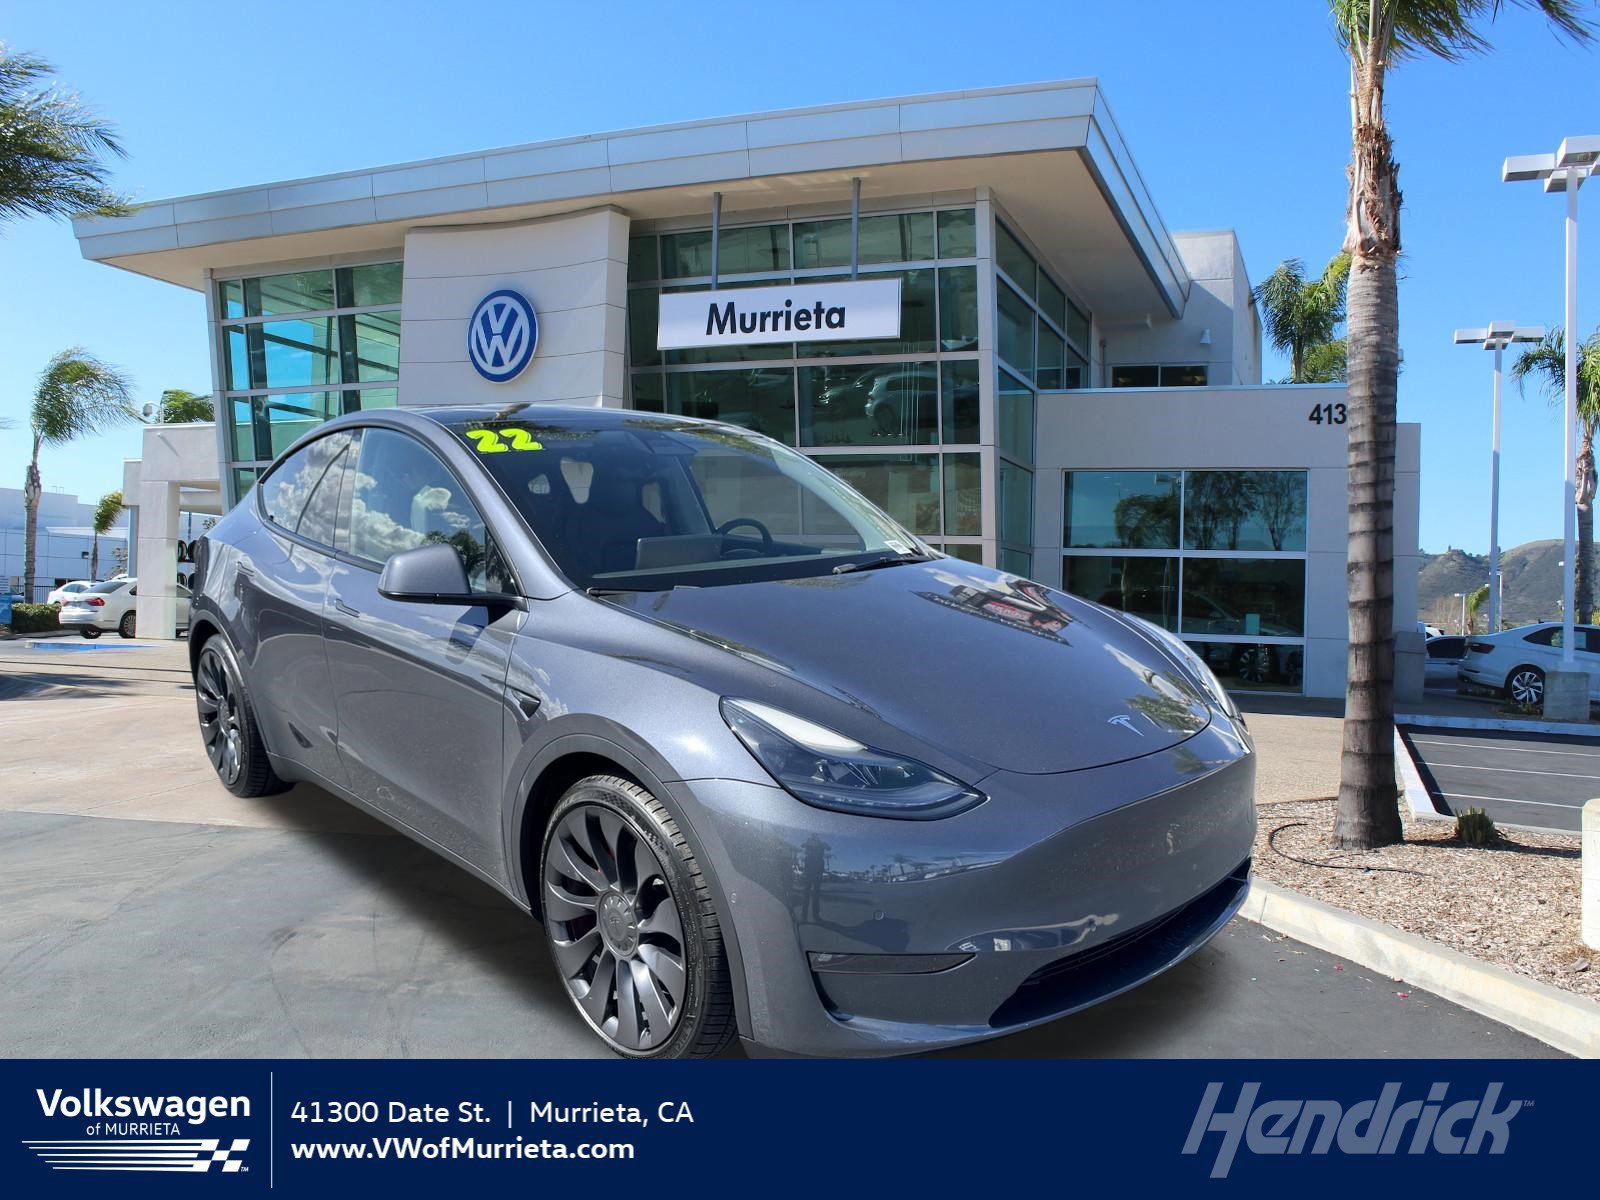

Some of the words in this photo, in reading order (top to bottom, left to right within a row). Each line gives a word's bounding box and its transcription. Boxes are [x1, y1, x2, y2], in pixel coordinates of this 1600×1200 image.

[706, 299, 846, 336] Murrieta
[1309, 403, 1347, 425] 413
[466, 428, 542, 453] 22
